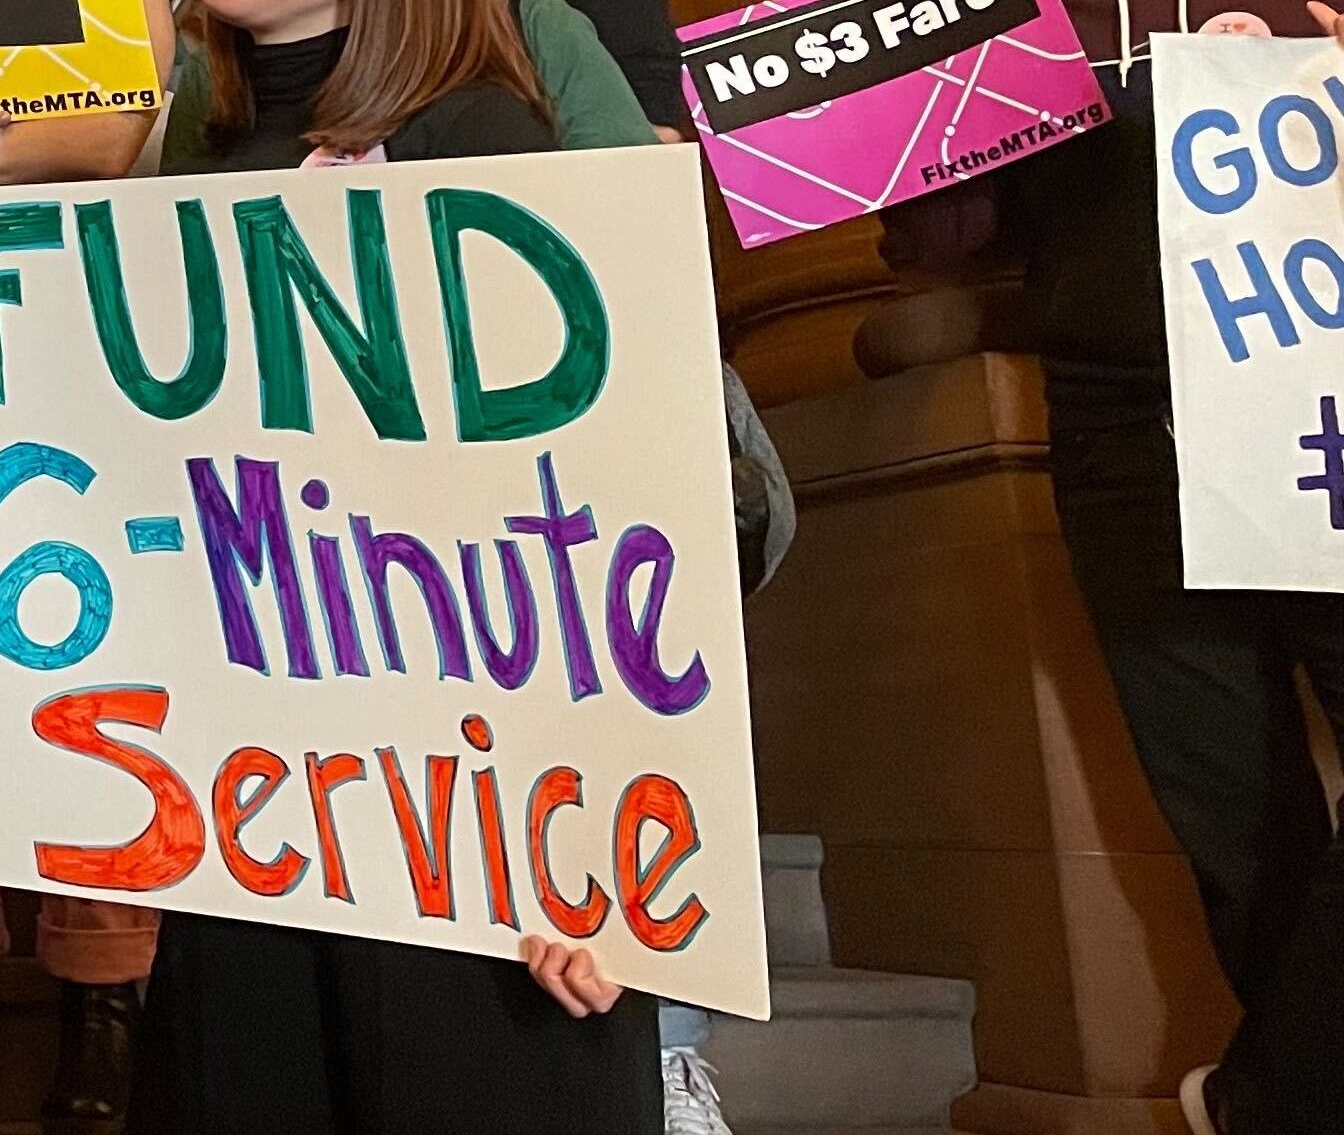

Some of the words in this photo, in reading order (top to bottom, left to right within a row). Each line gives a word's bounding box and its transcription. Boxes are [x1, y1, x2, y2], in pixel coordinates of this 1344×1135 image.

[706, 50, 790, 103] No
[793, 20, 872, 78] $3
[920, 102, 1104, 186] FixtheMTA.org
[32, 684, 711, 954] Service
